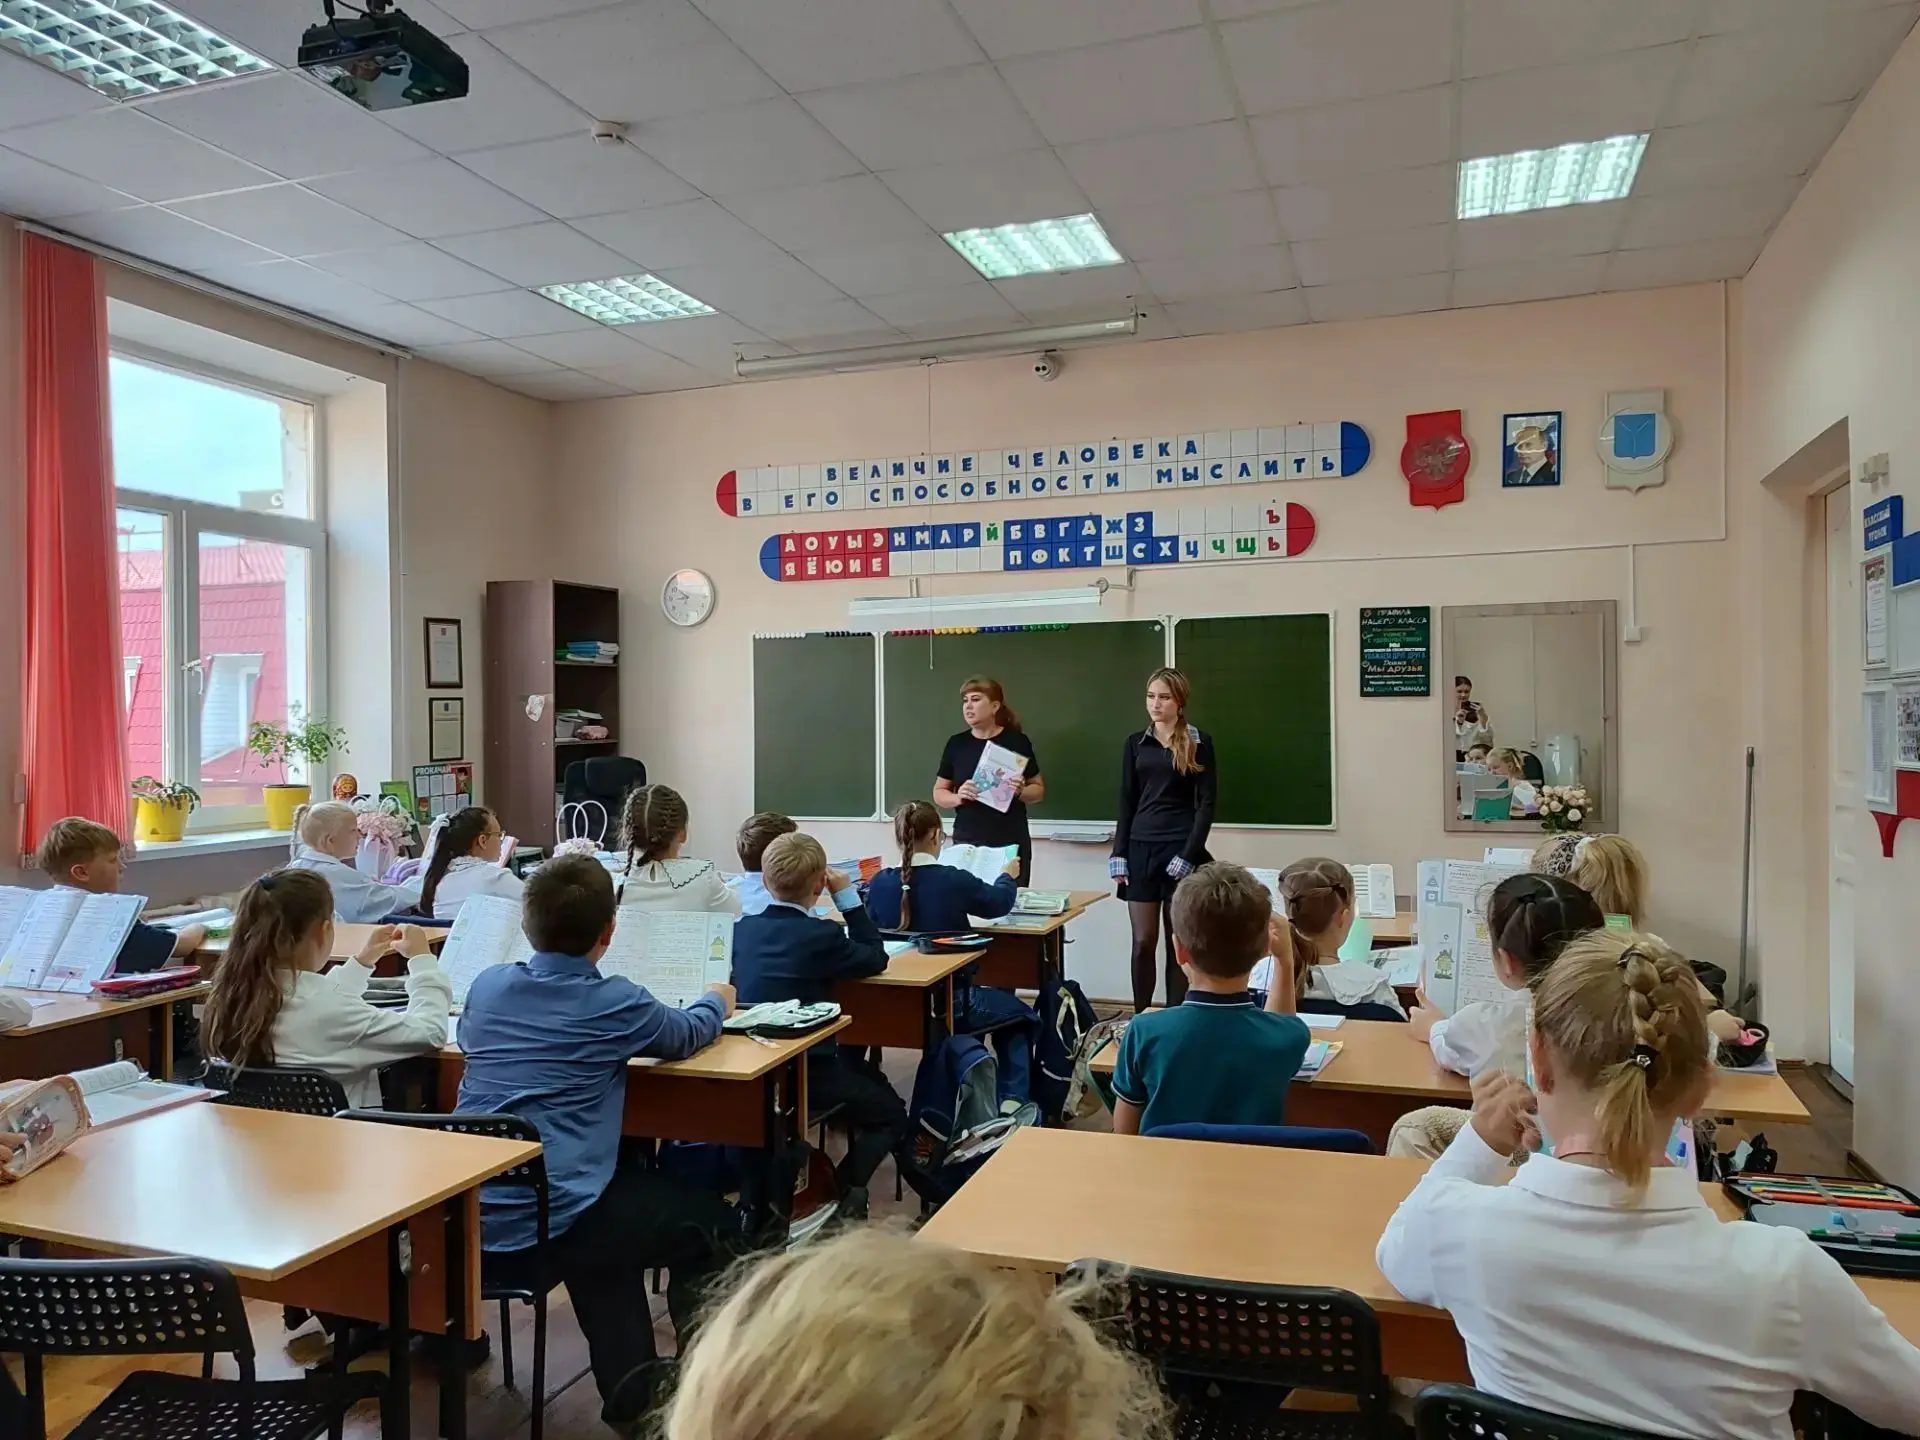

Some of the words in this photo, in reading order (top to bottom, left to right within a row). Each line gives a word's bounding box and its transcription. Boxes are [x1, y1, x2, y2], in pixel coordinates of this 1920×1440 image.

[742, 498, 752, 511] В
[784, 491, 839, 508] ЕГО
[869, 473, 1119, 502] СПОСОБНОСТИ
[1156, 457, 1335, 484] МЫСЛИТЬ
[826, 456, 973, 481] ВЕЛИЧИЕ
[1007, 440, 1198, 468] ЧЕЛОВЕКА
